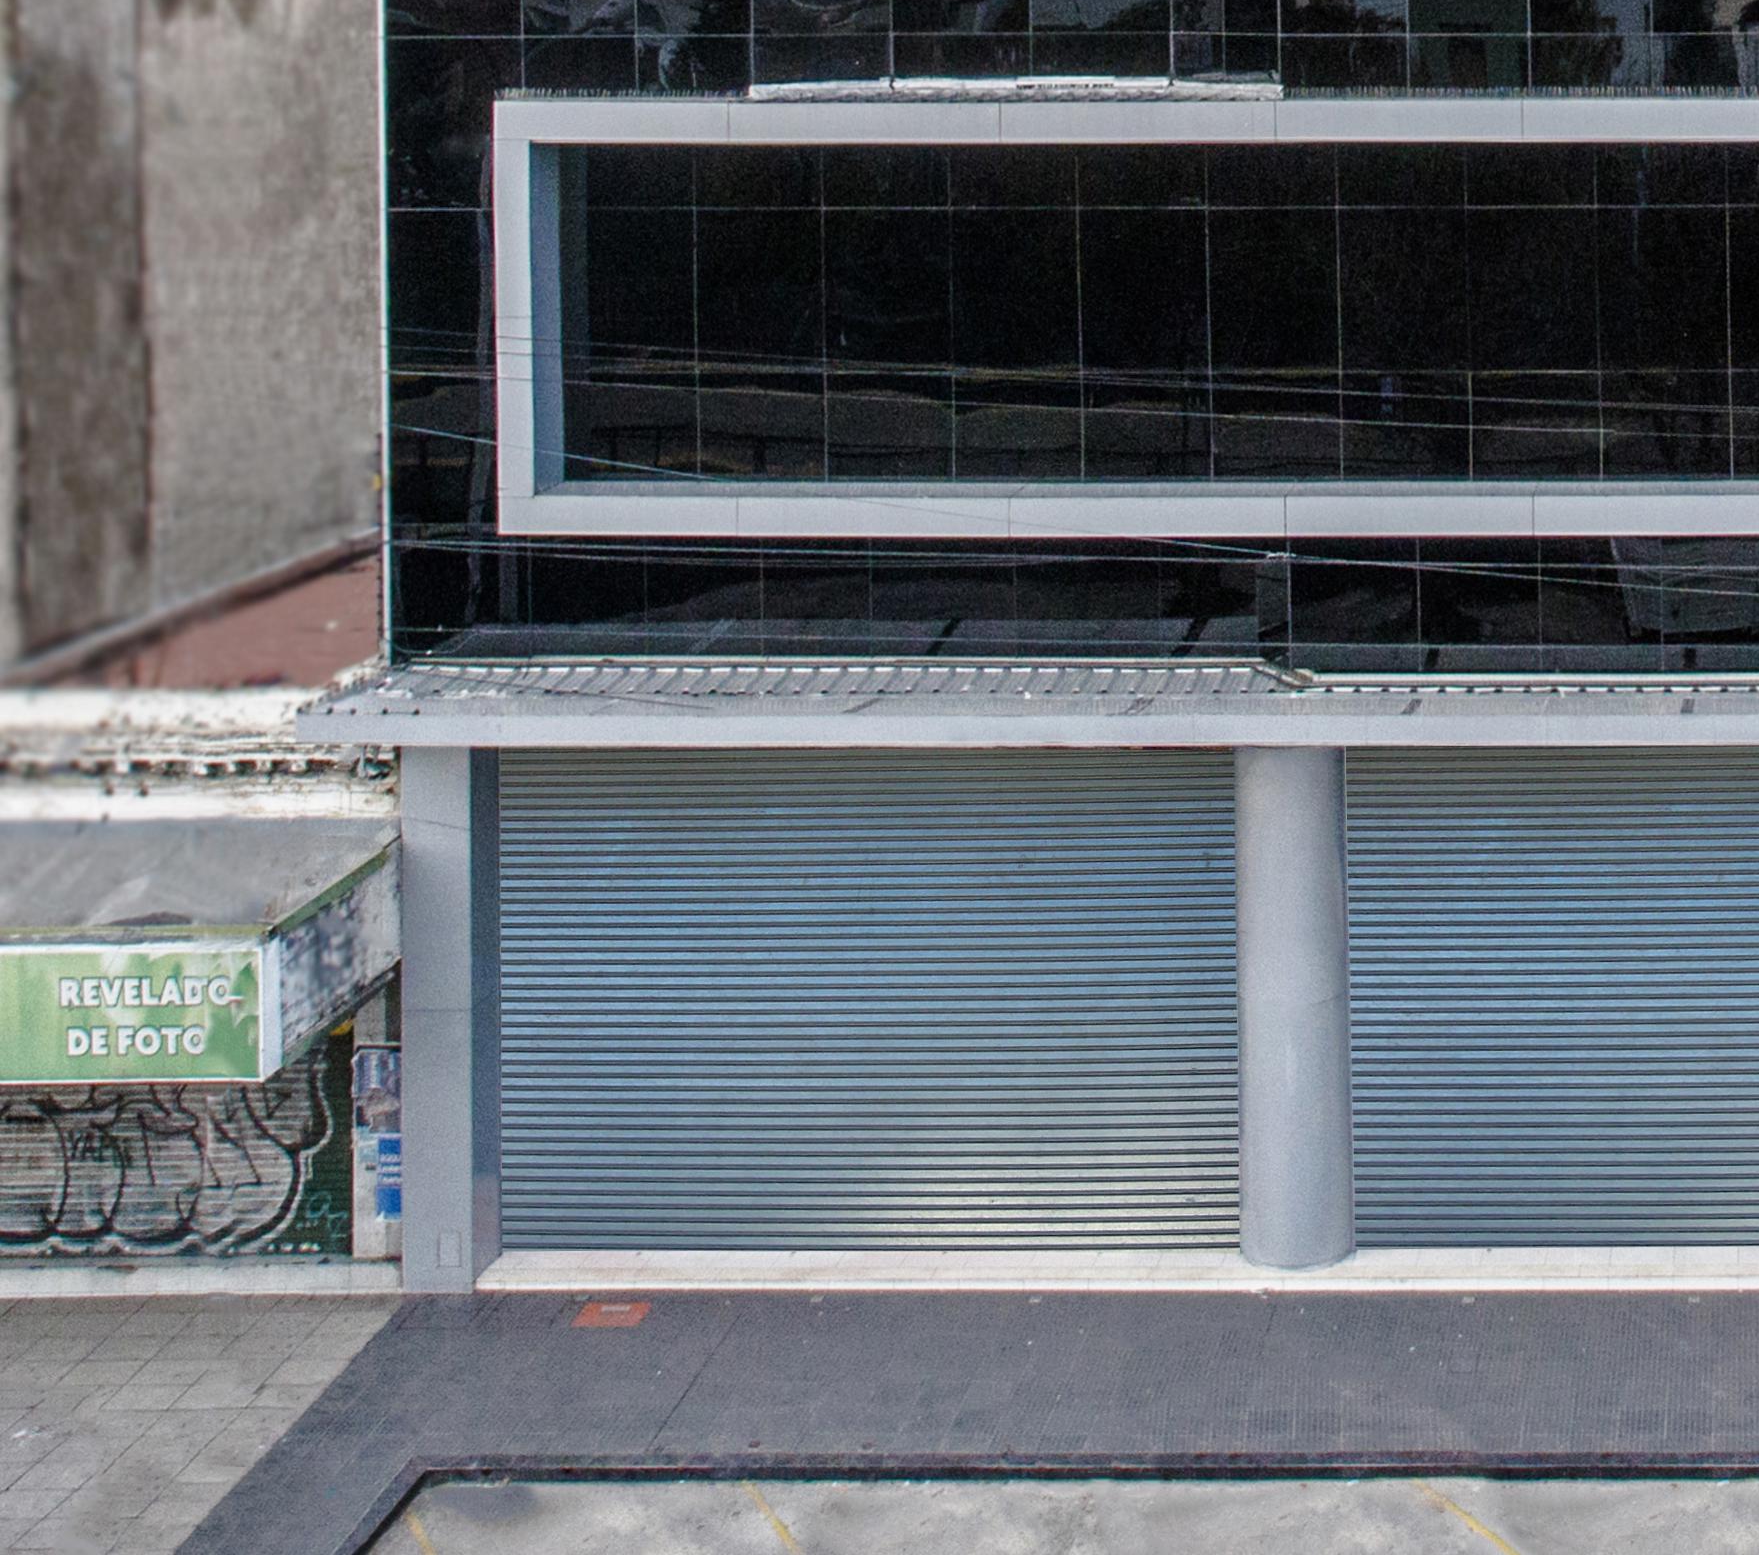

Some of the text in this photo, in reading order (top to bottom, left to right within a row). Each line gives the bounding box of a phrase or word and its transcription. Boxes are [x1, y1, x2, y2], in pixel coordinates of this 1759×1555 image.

[59, 975, 230, 1007] REVELADO
[67, 1025, 205, 1056] DE FOTO
